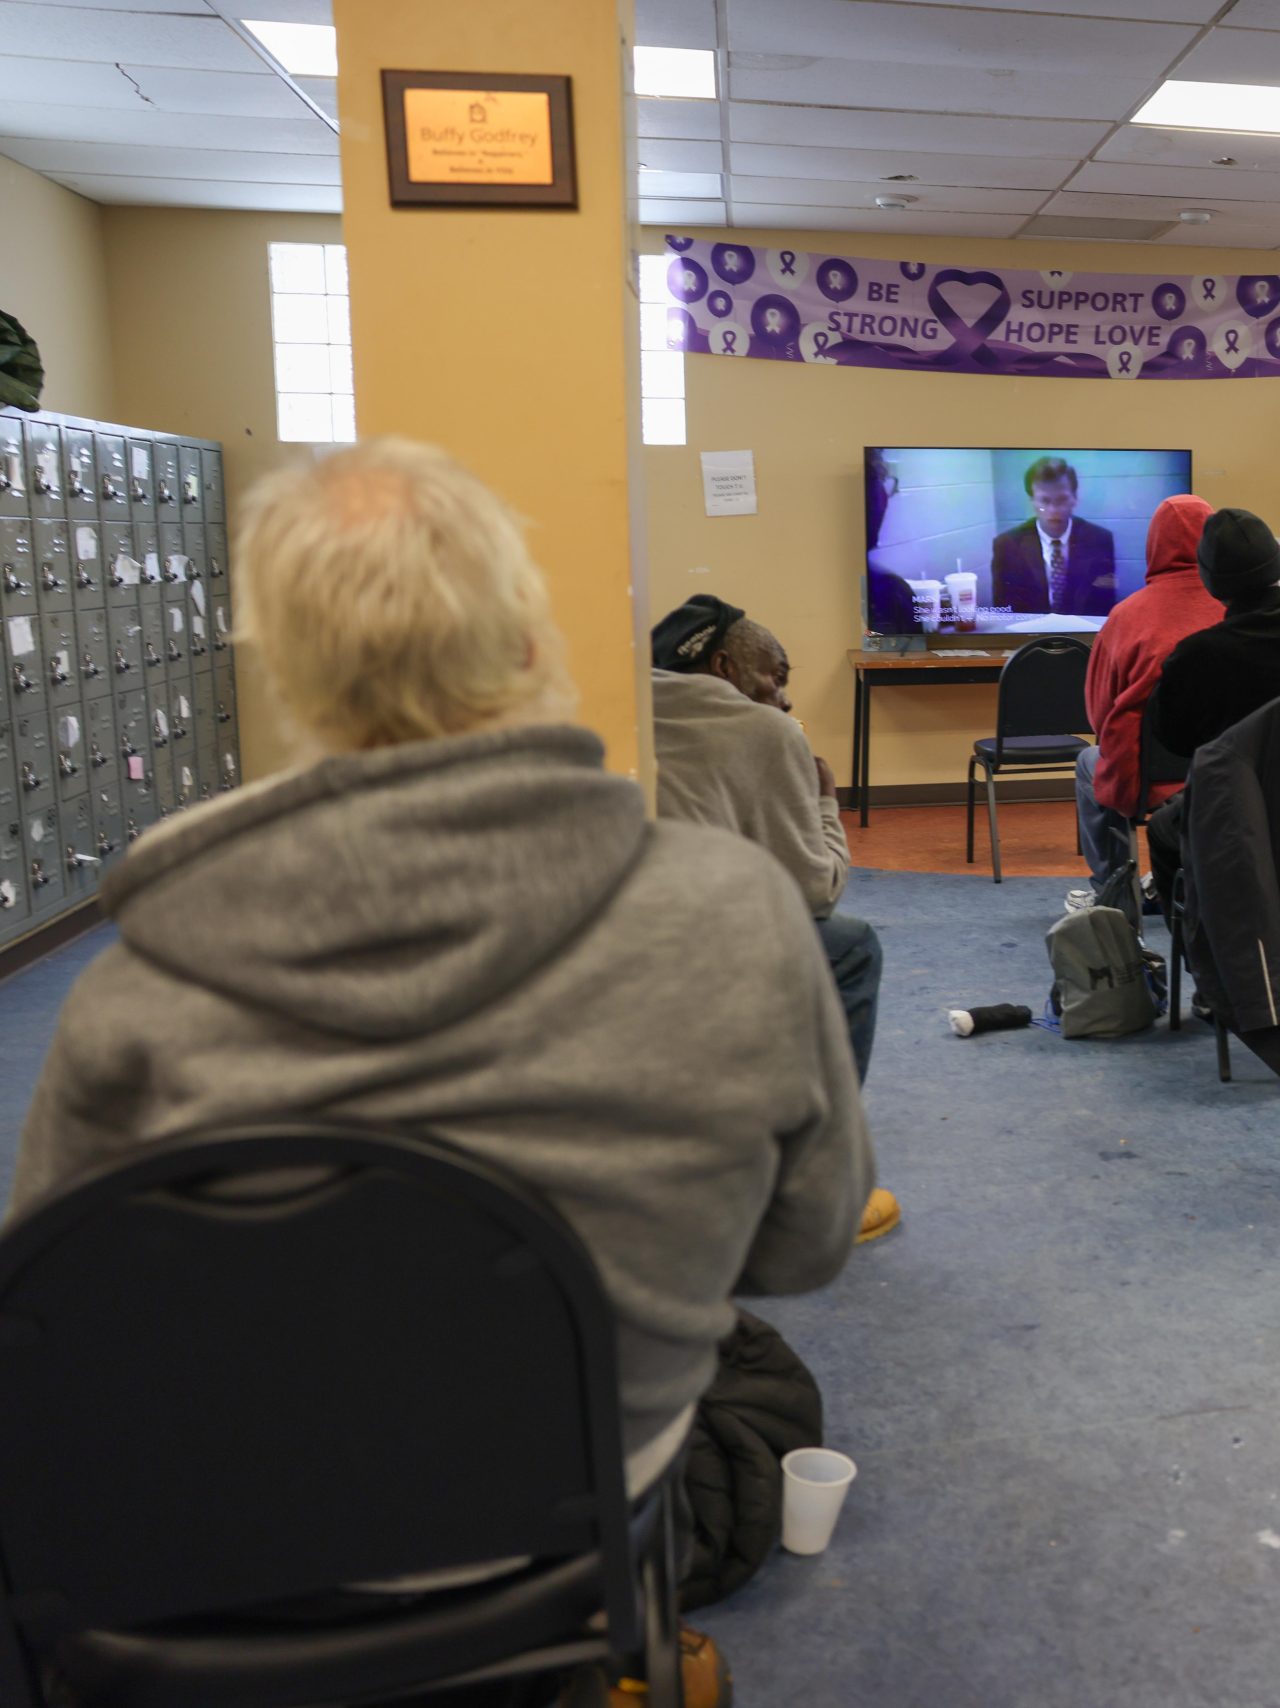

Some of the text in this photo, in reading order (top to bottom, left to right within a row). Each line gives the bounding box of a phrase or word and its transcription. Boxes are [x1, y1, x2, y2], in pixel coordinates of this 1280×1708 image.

[420, 127, 537, 148] Buffy Godfrey
[867, 282, 900, 303] BE
[1021, 289, 1144, 313] SUPPORT
[828, 311, 938, 339] STRONG
[1005, 320, 1161, 346] HOPE LOVE
